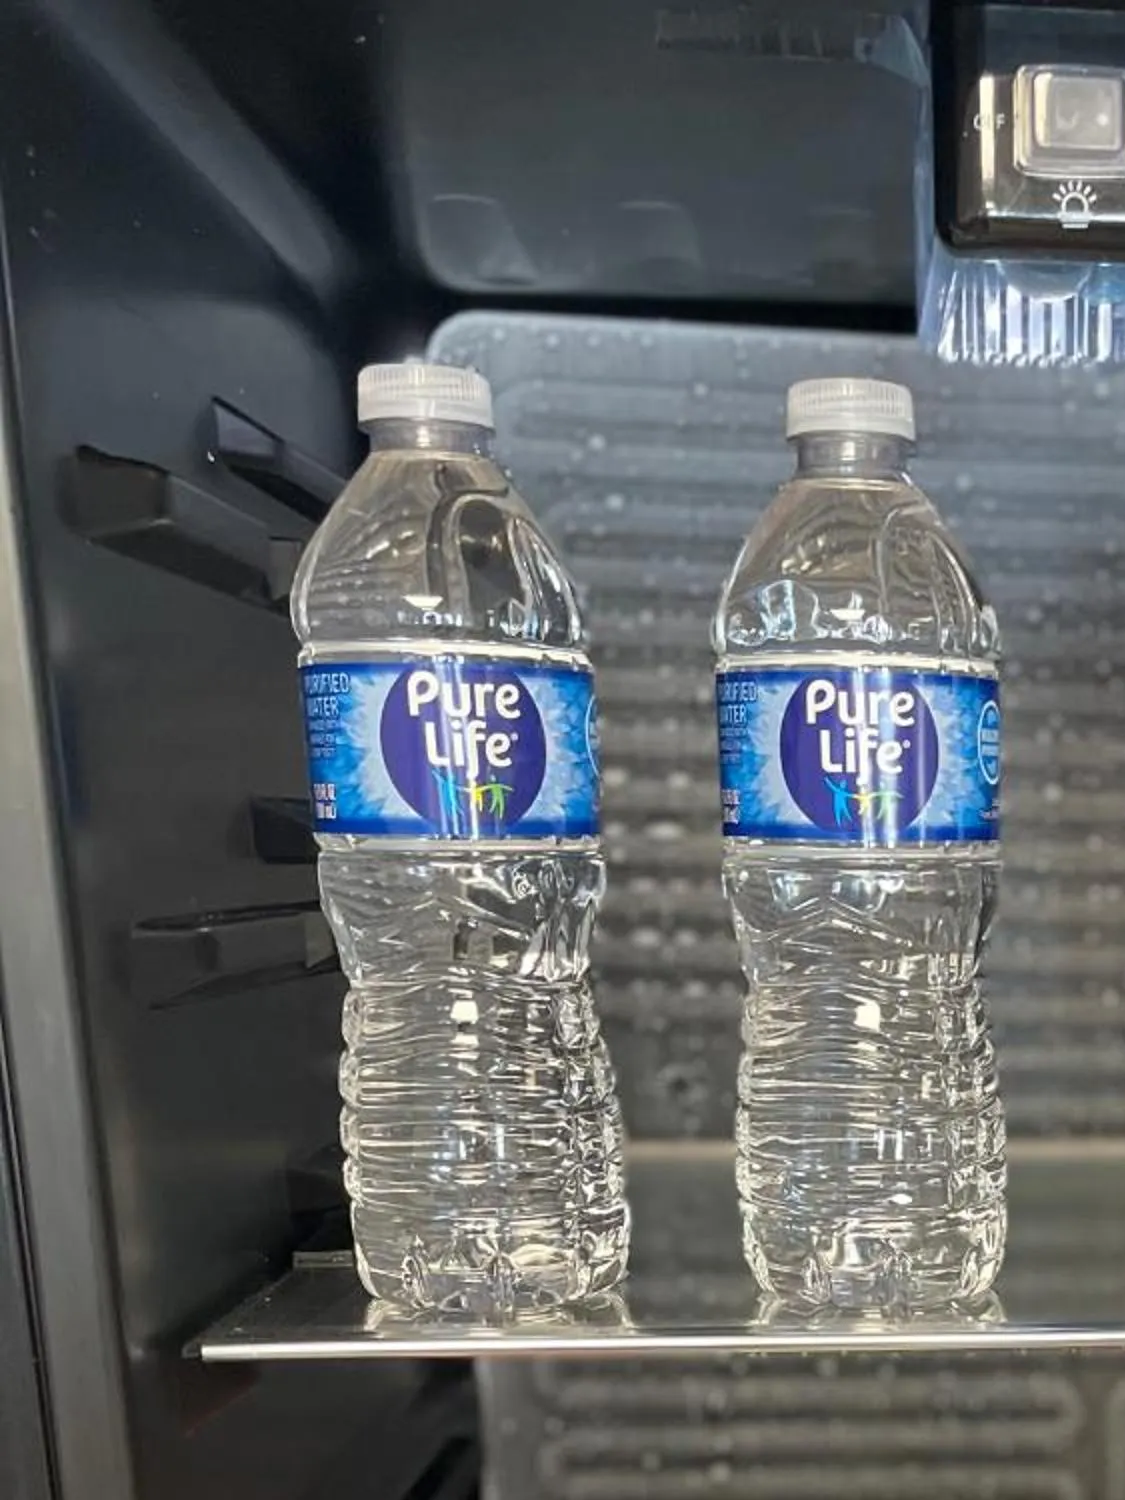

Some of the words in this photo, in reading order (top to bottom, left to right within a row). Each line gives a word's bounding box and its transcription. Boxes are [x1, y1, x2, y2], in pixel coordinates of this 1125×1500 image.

[406, 669, 521, 719] Pure
[805, 679, 915, 726] Pure
[424, 719, 513, 780] Life
[819, 728, 904, 786] Life
